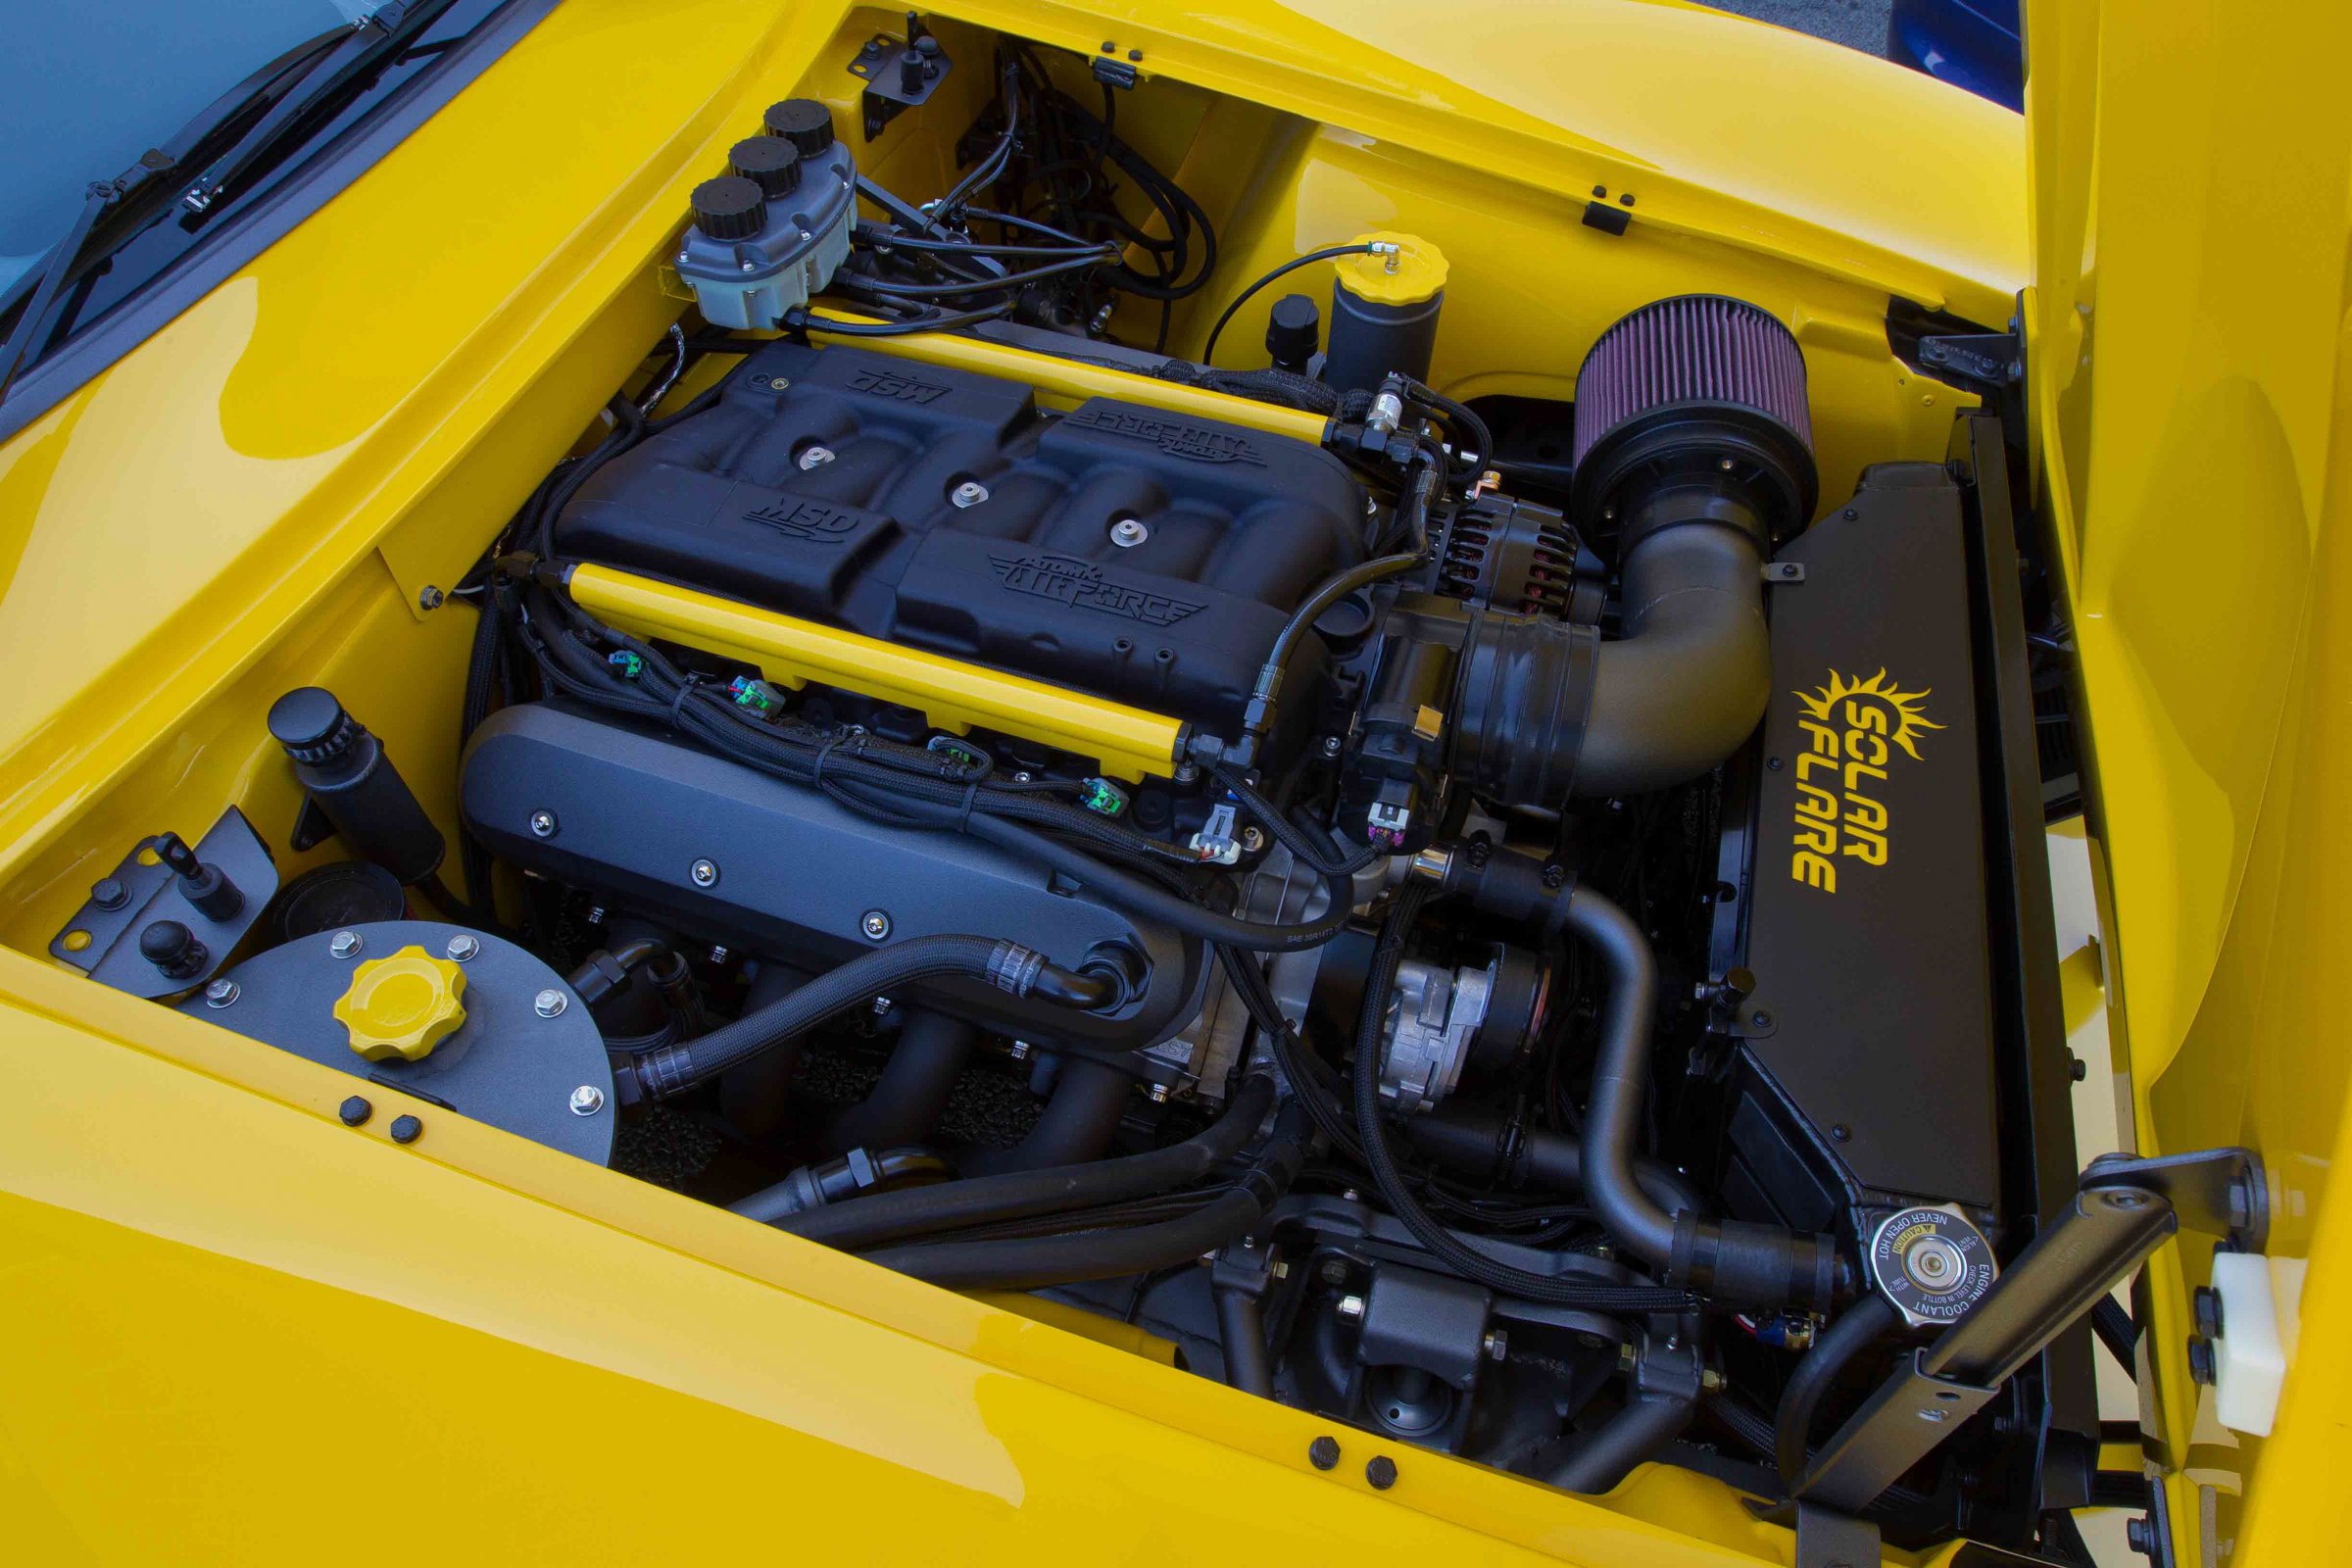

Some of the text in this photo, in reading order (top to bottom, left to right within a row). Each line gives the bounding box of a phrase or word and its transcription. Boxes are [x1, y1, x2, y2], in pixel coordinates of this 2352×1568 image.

[845, 372, 951, 404] MSD
[748, 495, 860, 534] MSD
[1843, 700, 1888, 867] SOLAR
[1791, 718, 1839, 895] FLARE
[1879, 1212, 1947, 1260] NEVER OPEN HOT
[1893, 1225, 1922, 1252] CAUTION
[1913, 1264, 1989, 1316] ENGINE COOLANT
[1923, 1265, 1977, 1303] CHECK LEVEL IN BOTTLE
